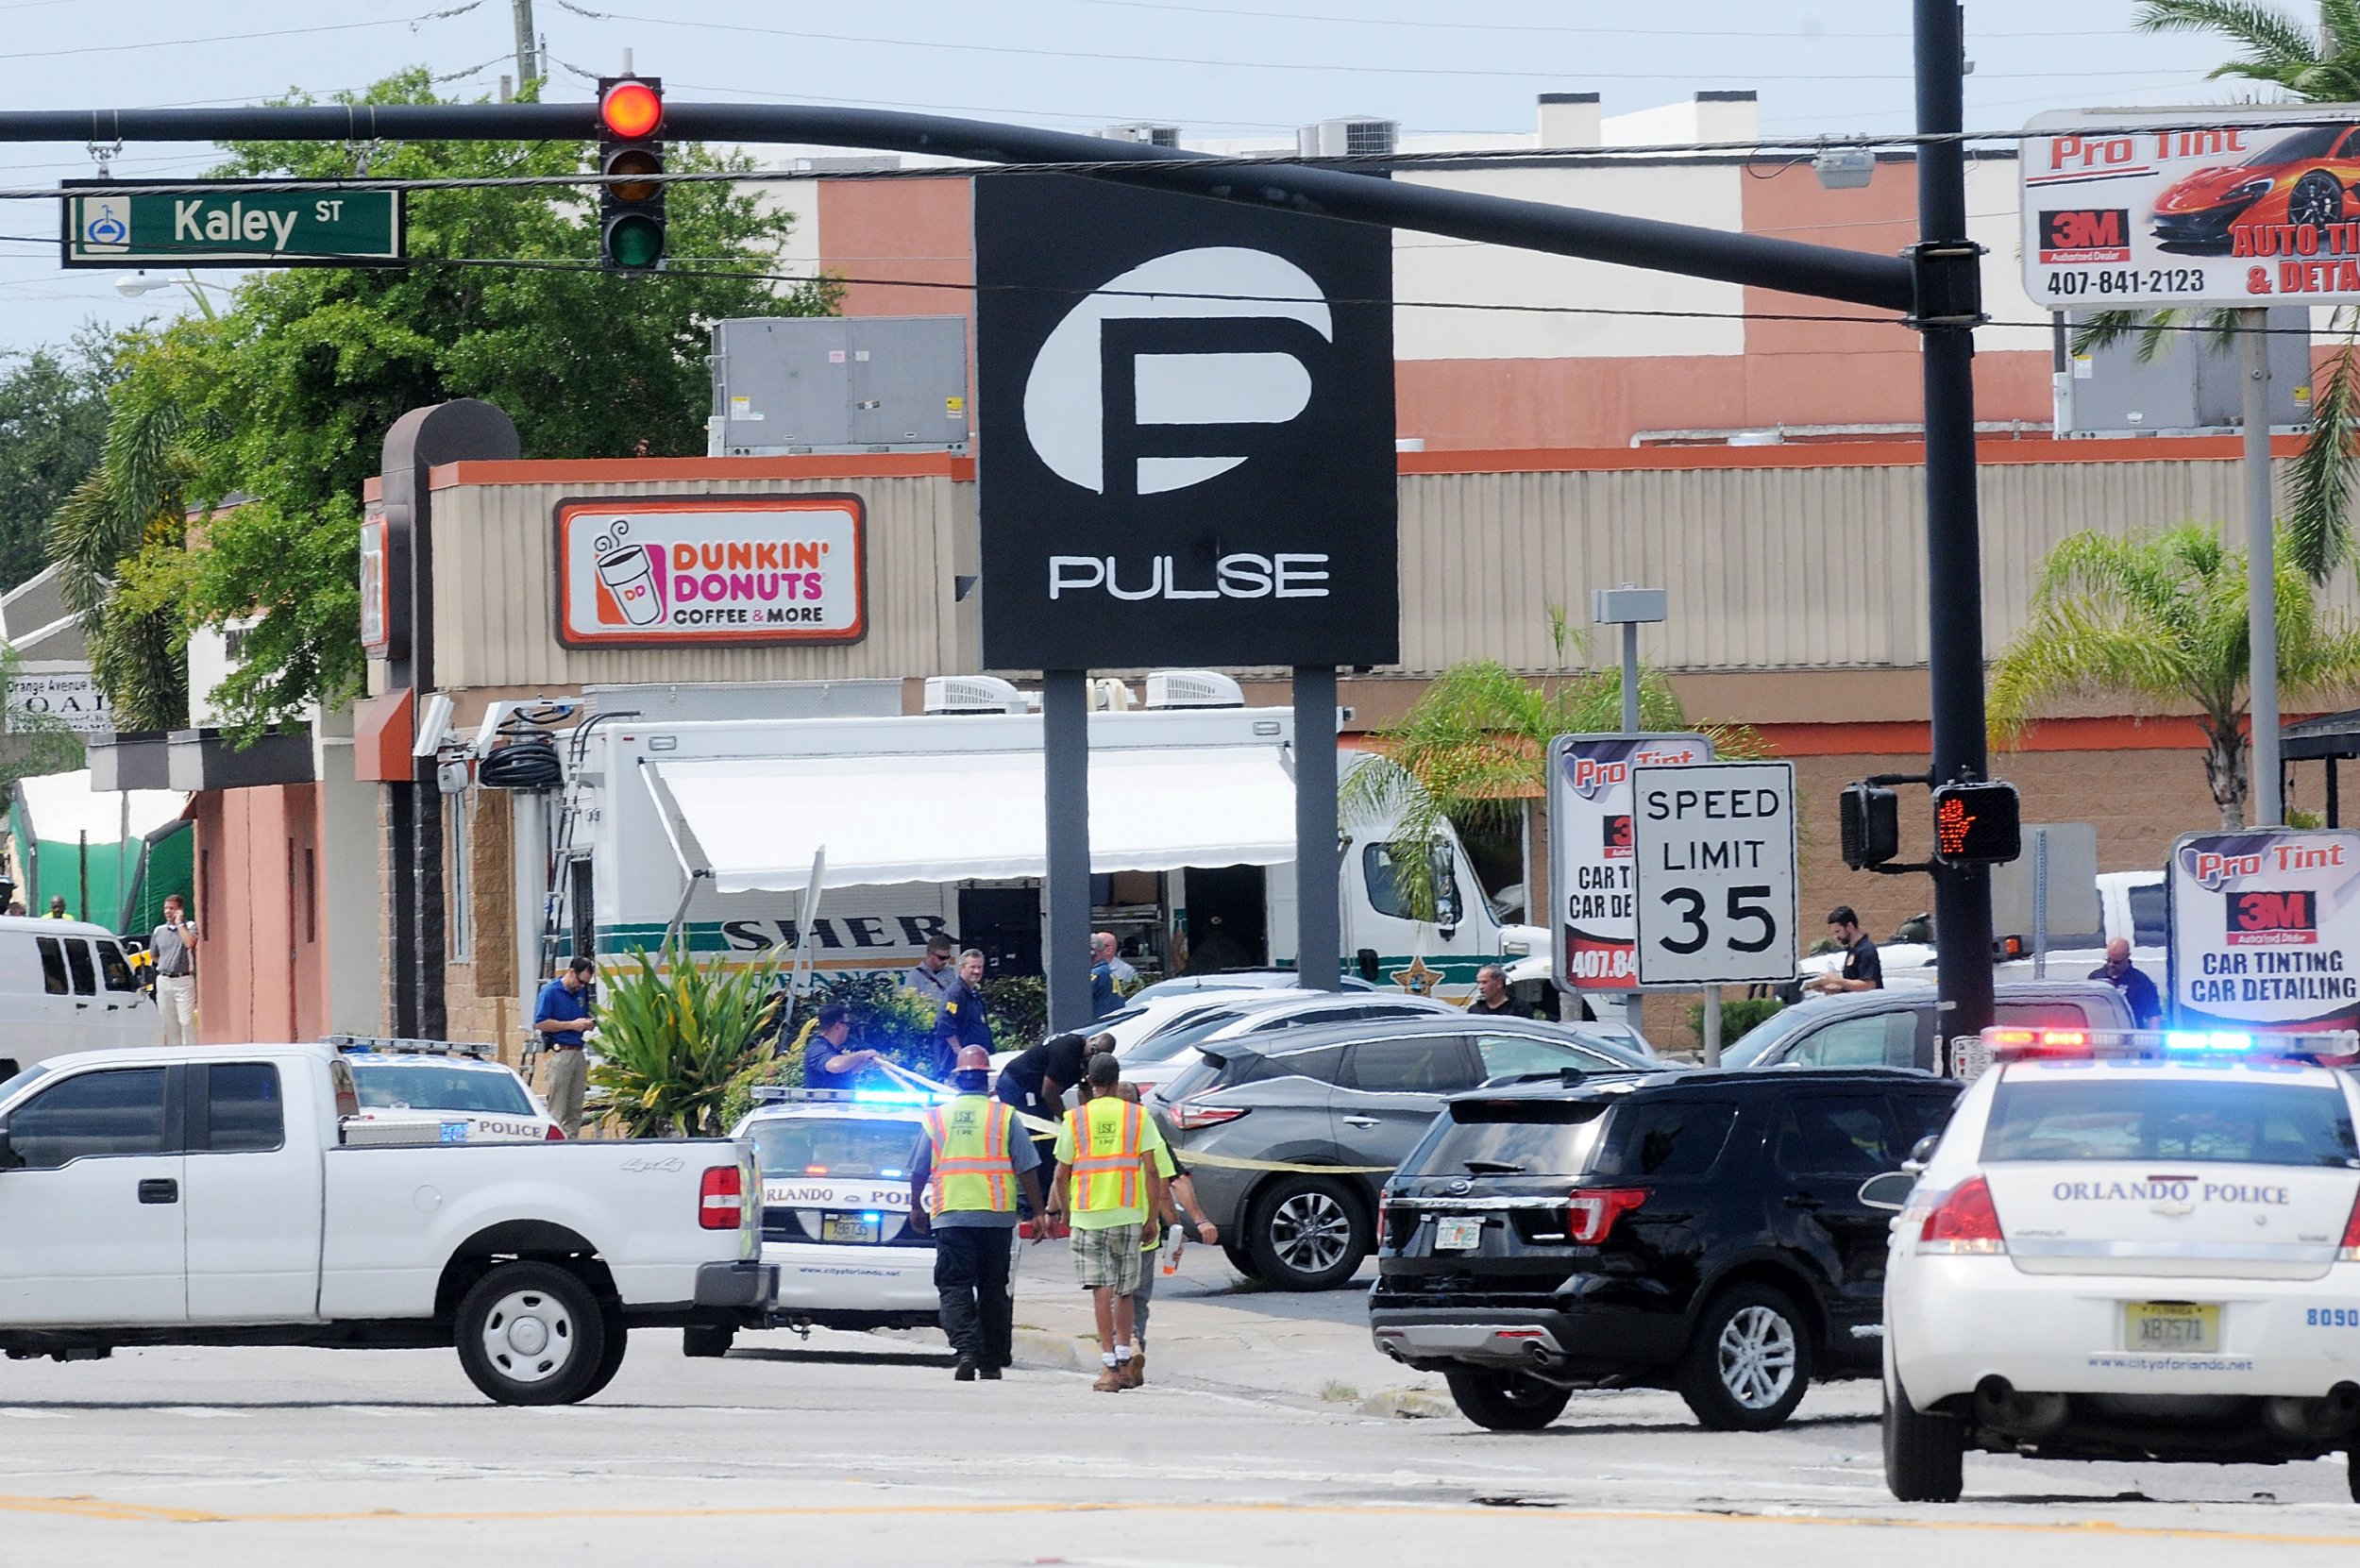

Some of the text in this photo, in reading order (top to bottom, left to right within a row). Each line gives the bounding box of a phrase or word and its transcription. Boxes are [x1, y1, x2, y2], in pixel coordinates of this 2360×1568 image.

[2050, 134, 2132, 170] Pro
[175, 200, 344, 261] Kaley ST
[2051, 211, 2119, 248] 3M
[2232, 222, 2360, 258] AUTO TI
[2048, 269, 2204, 295] 407-841-2123
[2247, 265, 2272, 295] &
[673, 542, 829, 571] DUNKIN'
[674, 572, 822, 602] DONUTS
[1050, 553, 1330, 600] PULSE
[673, 607, 822, 624] COFFEE & MORE
[8, 682, 44, 695] Orange
[48, 680, 87, 692] Avenue
[1576, 761, 1626, 786] Pro
[1647, 789, 1778, 820] SPEED
[1664, 841, 1764, 870] LIMIT
[2198, 844, 2344, 880] Pro Tint
[1579, 867, 1614, 889] CAR
[1570, 895, 1605, 919] CAR
[1660, 885, 1777, 954] 35
[2238, 894, 2307, 931] 3M
[2202, 950, 2343, 975] CAR TINTING
[2191, 976, 2356, 1003] CAR DETAILING
[480, 1121, 542, 1138] POLICE
[619, 1157, 685, 1172] 4x4
[766, 1189, 834, 1202] RLANDO
[2052, 1182, 2290, 1206] ORLANDO POLICE
[2306, 1308, 2360, 1327] 8090
[2087, 1357, 2254, 1372] www.cityoforlando.net
